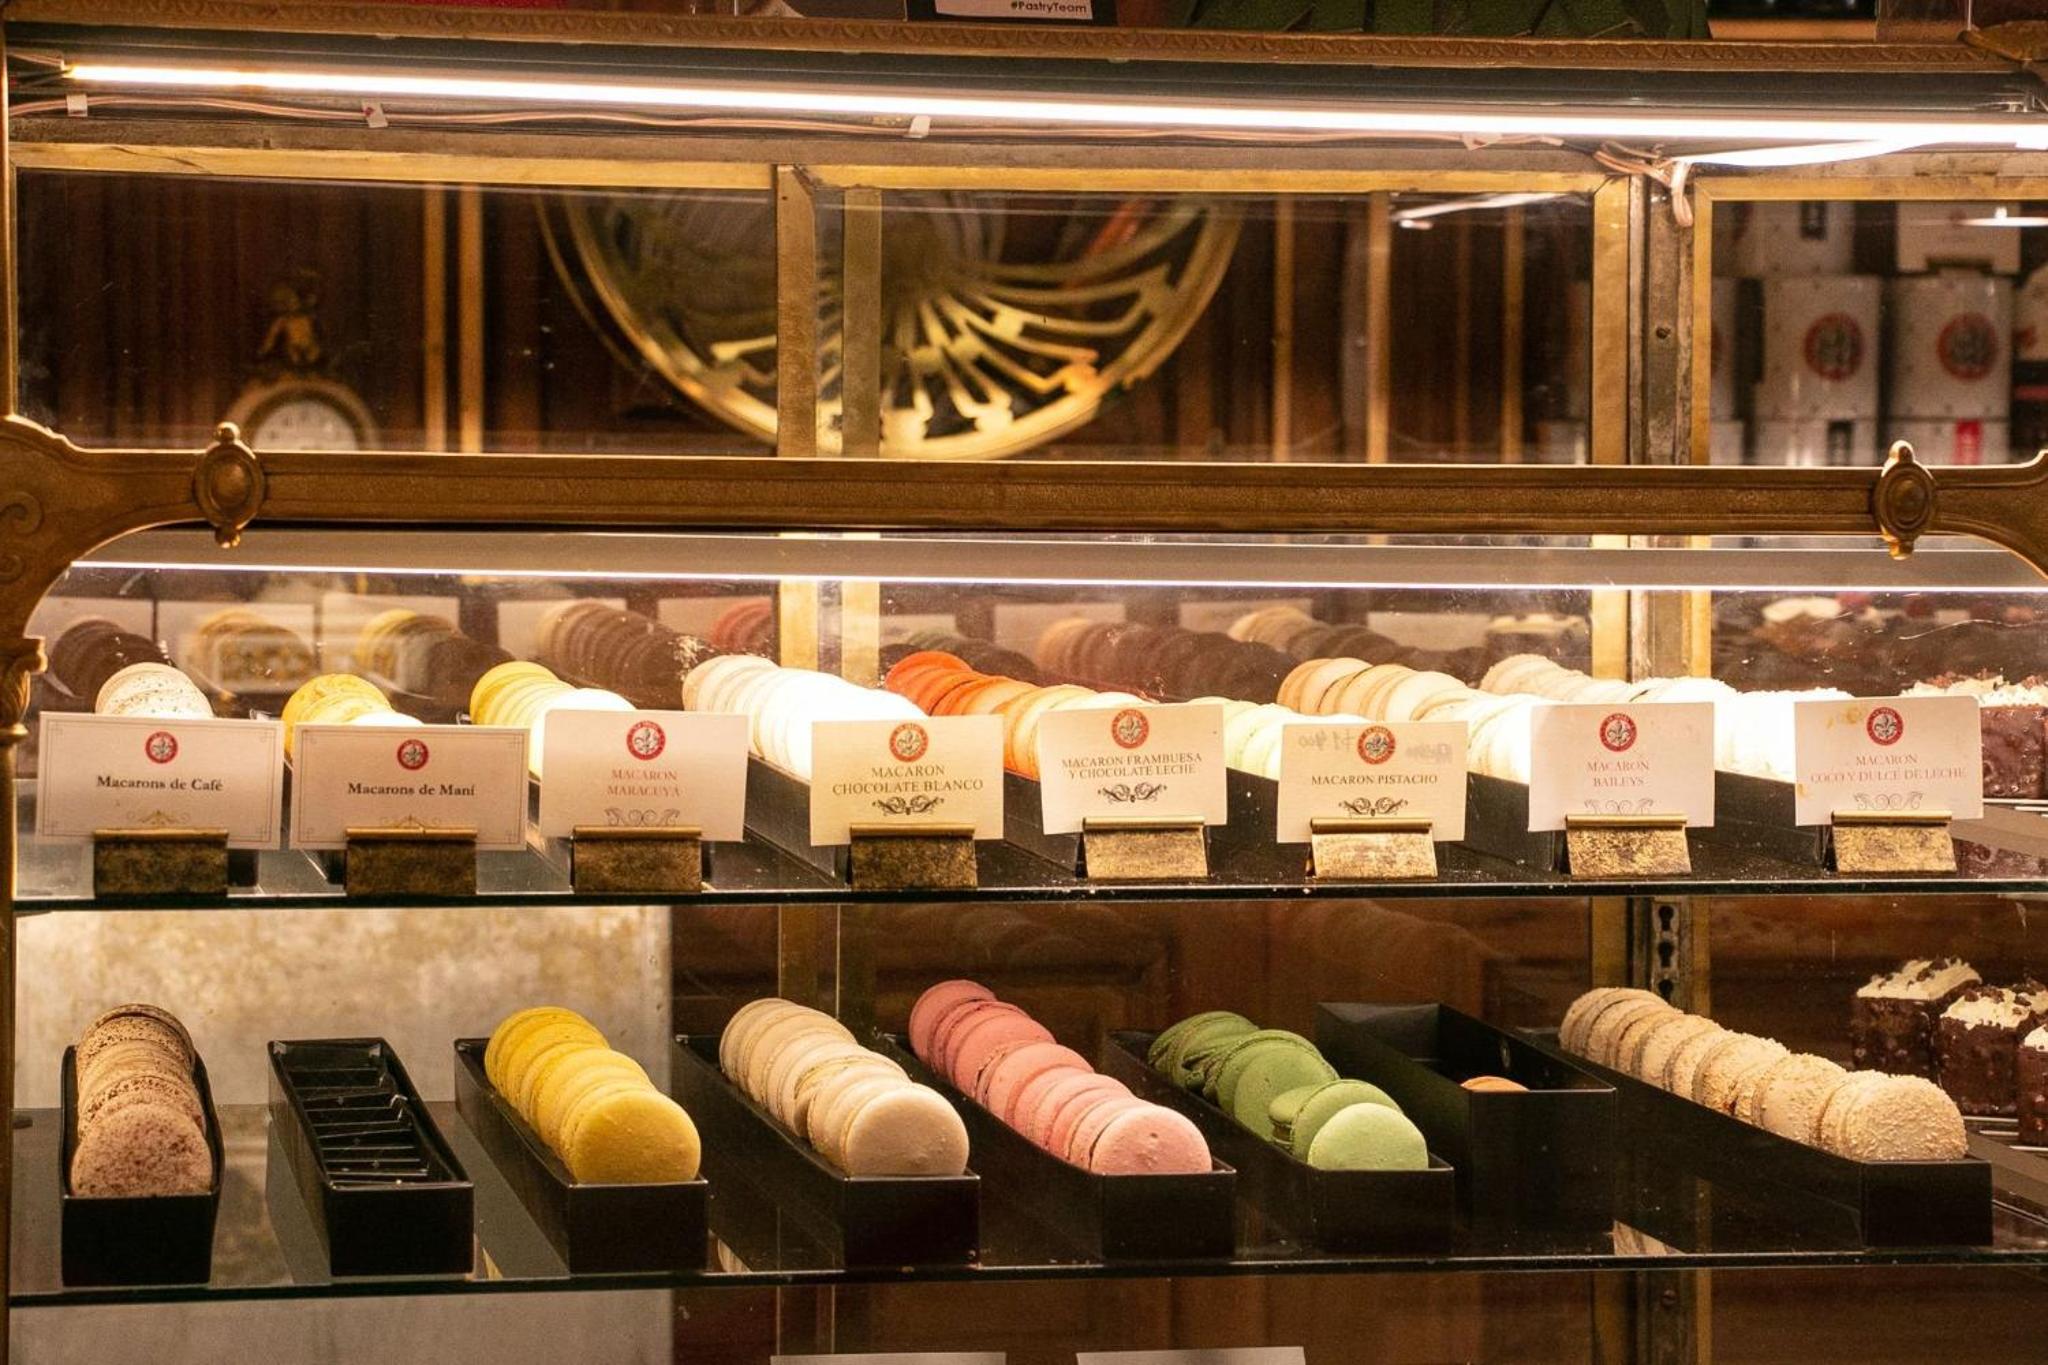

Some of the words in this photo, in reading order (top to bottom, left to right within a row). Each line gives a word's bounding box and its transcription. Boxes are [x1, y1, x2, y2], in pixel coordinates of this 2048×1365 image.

[1062, 756, 1123, 770] MACARON
[1128, 752, 1202, 765] FRAMBUESA
[1587, 760, 1650, 772] MACARON
[1856, 753, 1918, 766] MACARON
[611, 768, 678, 781] MACARON
[872, 764, 945, 778] MACARON
[1069, 769, 1077, 780] Y
[1079, 766, 1153, 779] CHOCOLATE
[1156, 763, 1196, 776] LECHE
[97, 775, 165, 789] Macarons
[170, 778, 186, 790] de
[191, 778, 223, 791] Café
[1311, 774, 1374, 786] MACARON
[1378, 773, 1438, 785] PISTACHO
[348, 782, 415, 795] Macarons
[418, 784, 436, 795] de
[439, 783, 475, 796] Maní
[832, 780, 919, 796] CHOCOLATE
[923, 778, 984, 793] BLANCO
